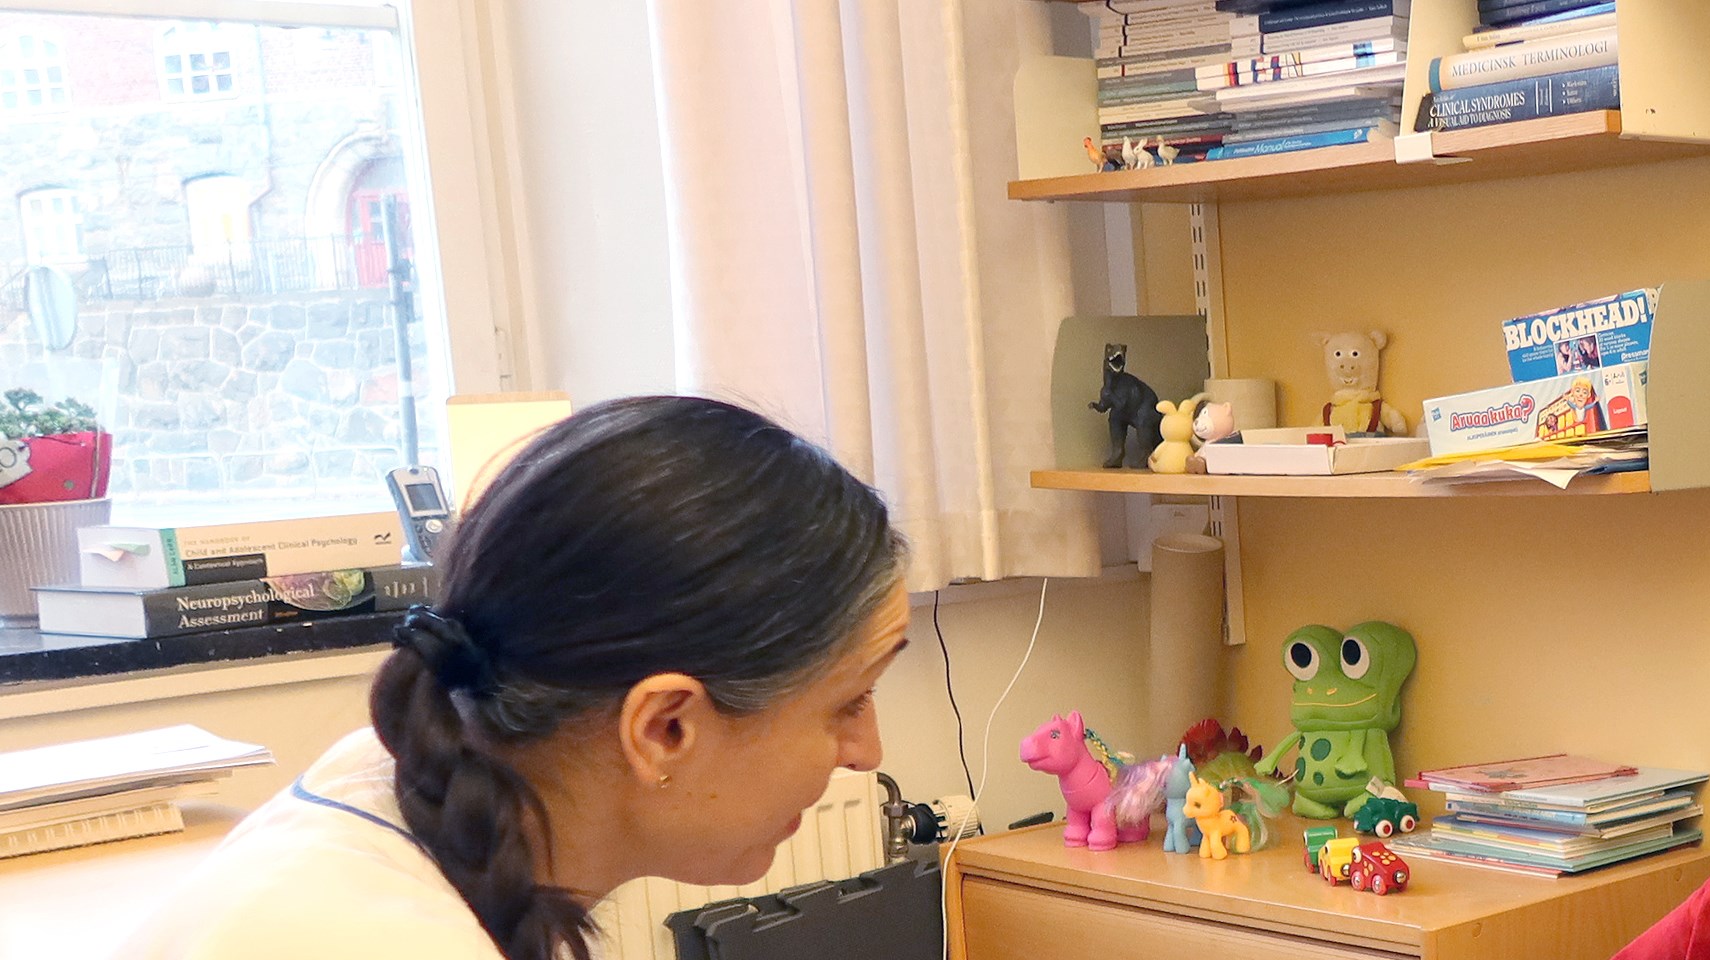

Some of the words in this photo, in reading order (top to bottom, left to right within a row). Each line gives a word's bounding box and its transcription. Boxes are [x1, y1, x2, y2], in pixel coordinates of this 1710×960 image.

[1452, 56, 1517, 77] MEDICINSK
[1522, 40, 1609, 66] TERMINOLOGI
[1429, 99, 1471, 117] CLINICAL
[1471, 91, 1526, 112] SYNDROMES
[1503, 297, 1648, 351] BLOCKHEAD!
[1488, 395, 1535, 424] kuka?
[278, 540, 309, 550] Clinical
[311, 537, 358, 547] Psychology
[176, 584, 316, 611] Neuropsychological
[178, 609, 265, 629] Assessment
